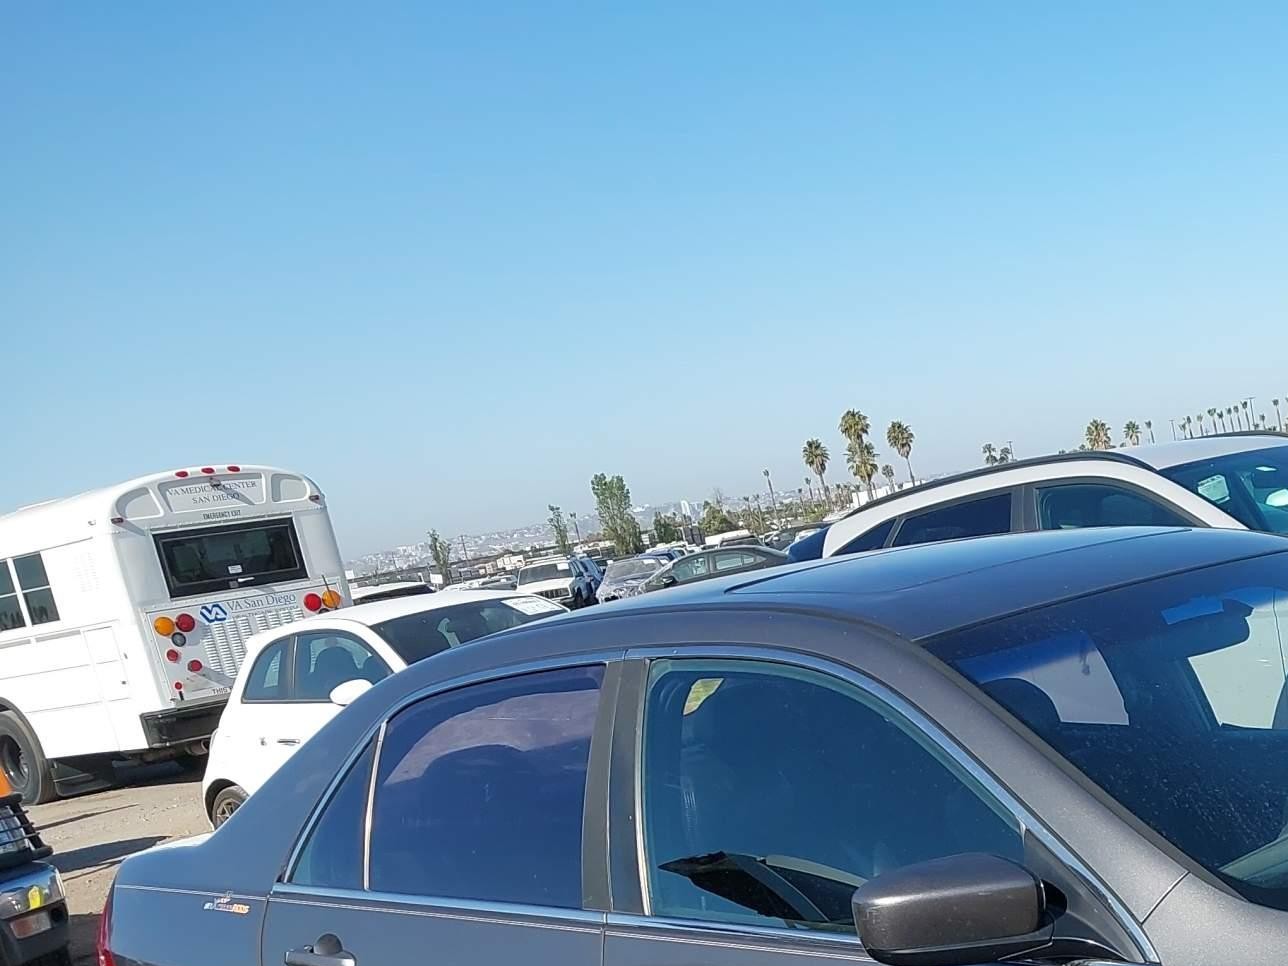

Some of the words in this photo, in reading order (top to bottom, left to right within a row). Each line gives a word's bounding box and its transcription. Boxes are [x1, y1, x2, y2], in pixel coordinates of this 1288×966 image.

[167, 486, 181, 496] VA
[223, 480, 257, 490] CENTER
[192, 495, 211, 505] SAN
[212, 493, 241, 502] DIEGO
[227, 601, 242, 611] VA
[244, 597, 264, 609] San
[266, 593, 297, 606] Diego
[212, 687, 229, 695] THIS
